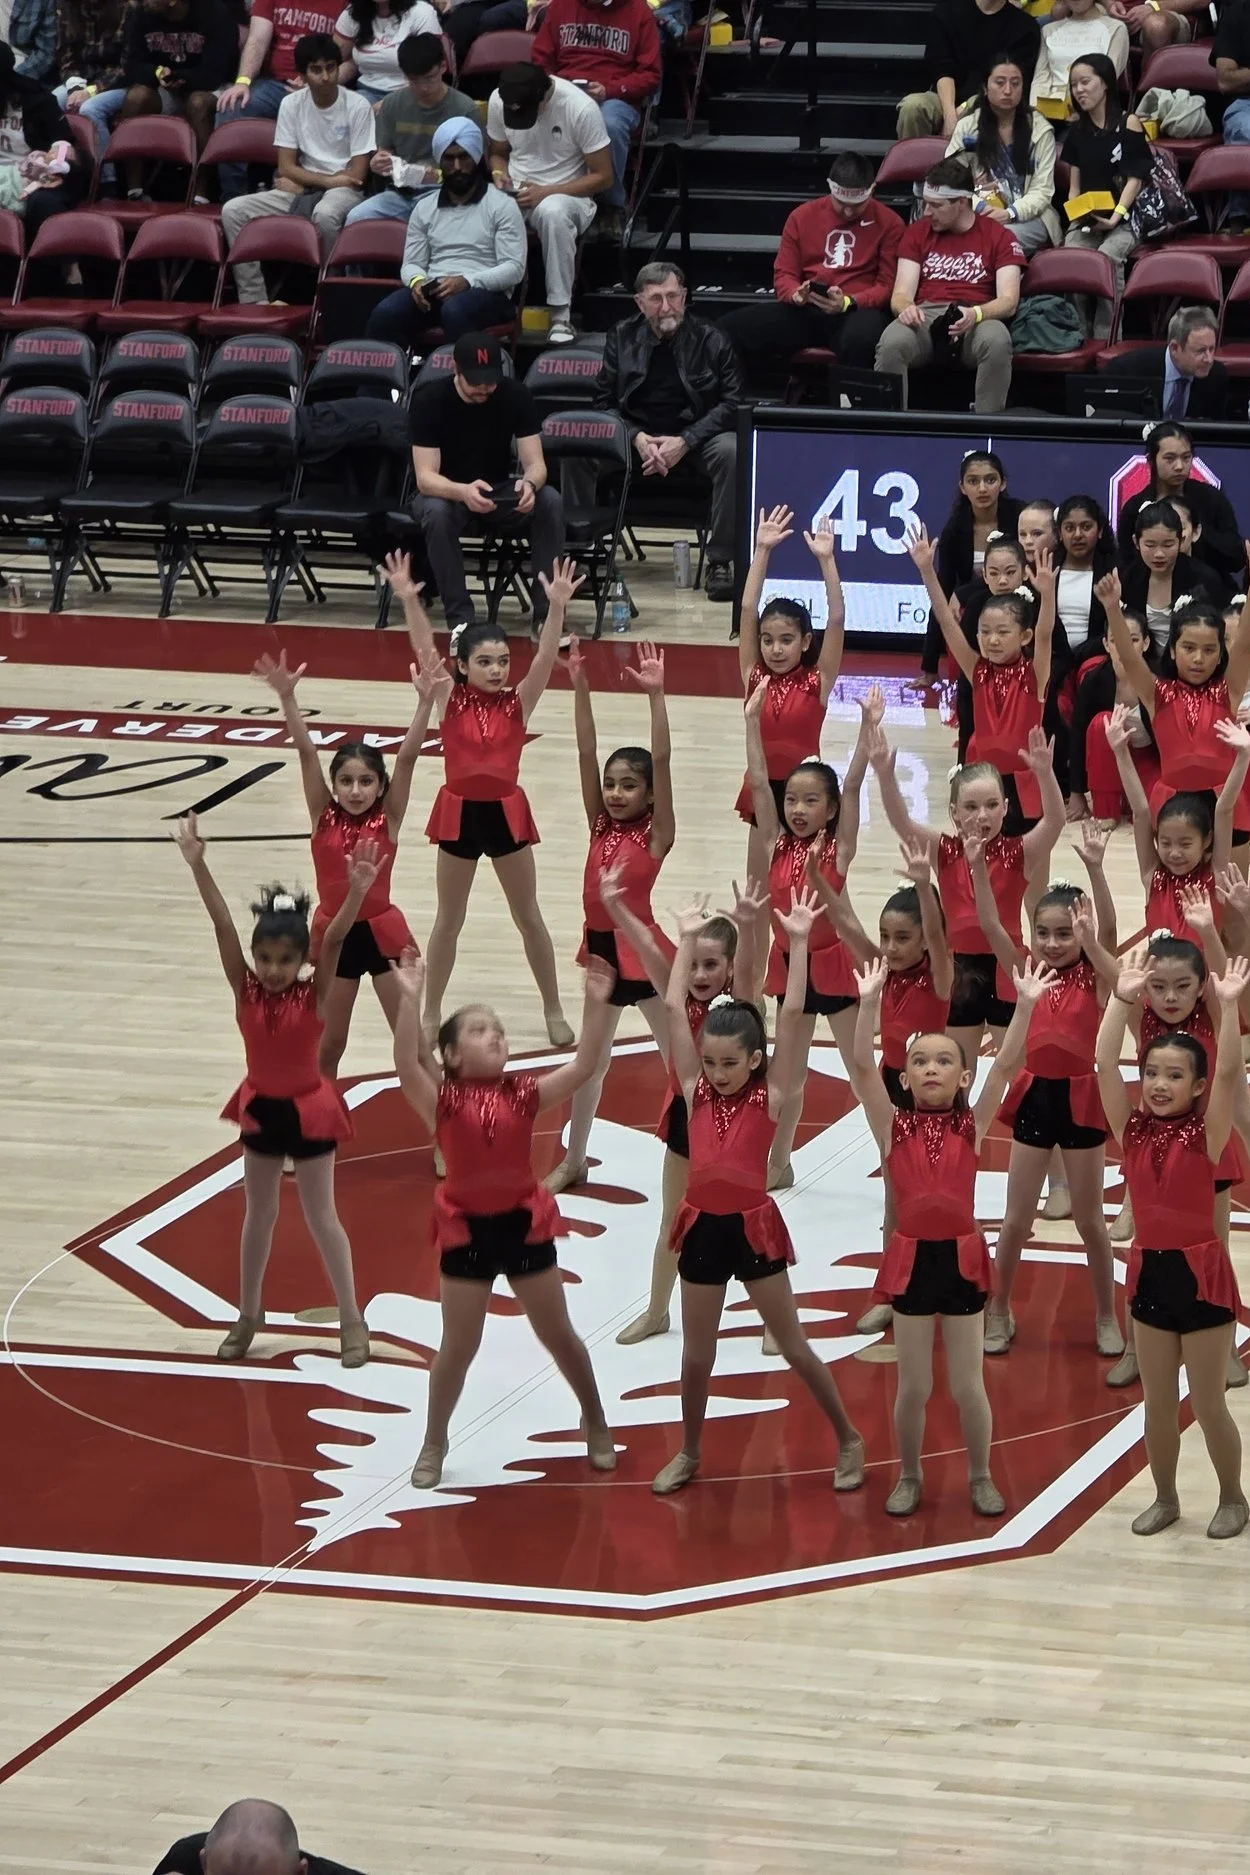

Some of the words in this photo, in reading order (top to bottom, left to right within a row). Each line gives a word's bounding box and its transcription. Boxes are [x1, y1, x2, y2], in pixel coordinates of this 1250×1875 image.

[15, 338, 84, 356] STANFORD
[118, 341, 188, 359] STANFORD
[223, 346, 292, 364] STANFORD
[327, 349, 397, 368] STANFORD
[476, 348, 489, 365] N
[537, 358, 603, 376] STANFOR
[6, 397, 77, 416] STANFORD
[113, 401, 184, 420] STANFORD
[220, 406, 291, 425] STANFORD
[544, 421, 616, 439] STANFORD
[811, 469, 923, 555] 43
